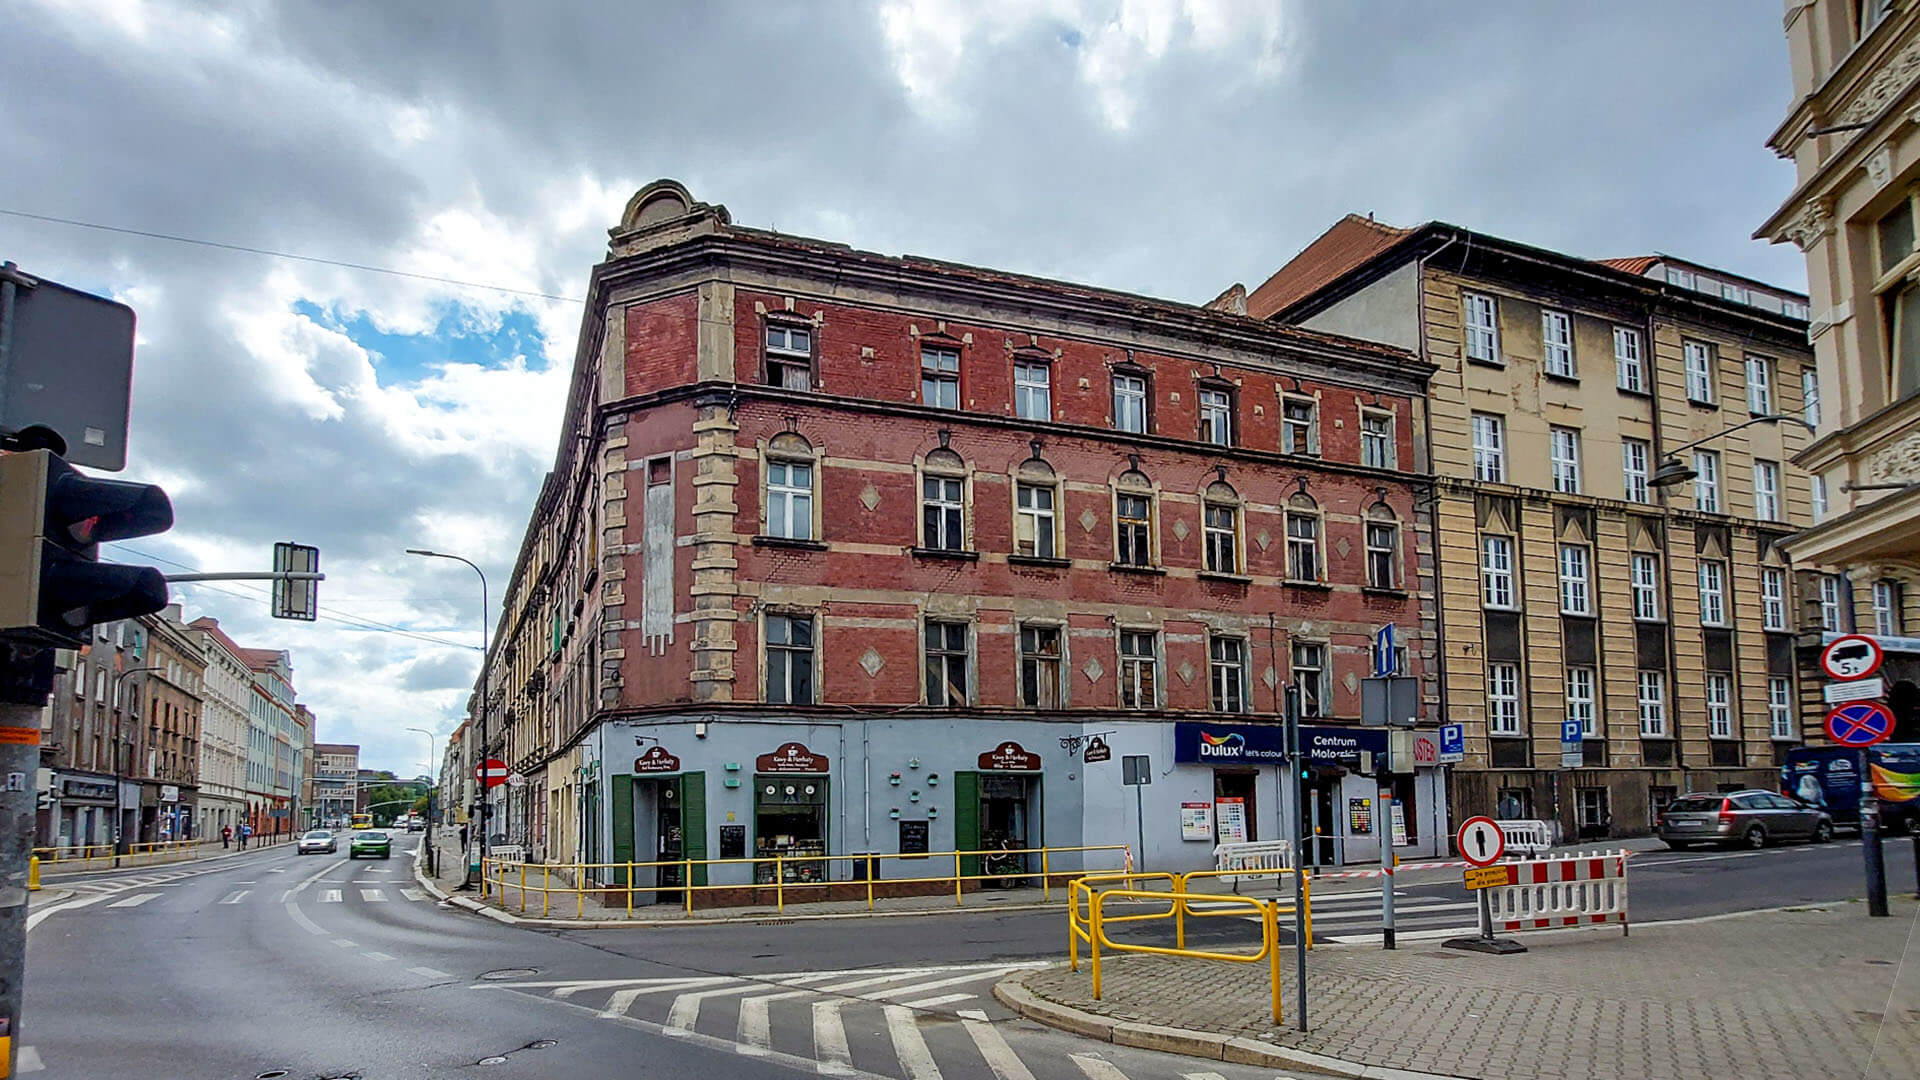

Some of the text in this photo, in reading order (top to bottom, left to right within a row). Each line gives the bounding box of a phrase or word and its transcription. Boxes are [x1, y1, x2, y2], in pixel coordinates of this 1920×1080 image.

[1840, 662, 1859, 675] 5 t
[1444, 727, 1458, 746] P
[1566, 723, 1578, 740] P
[1313, 735, 1357, 747] Centrum
[1200, 743, 1239, 757] Dulux
[1260, 749, 1283, 758] colour
